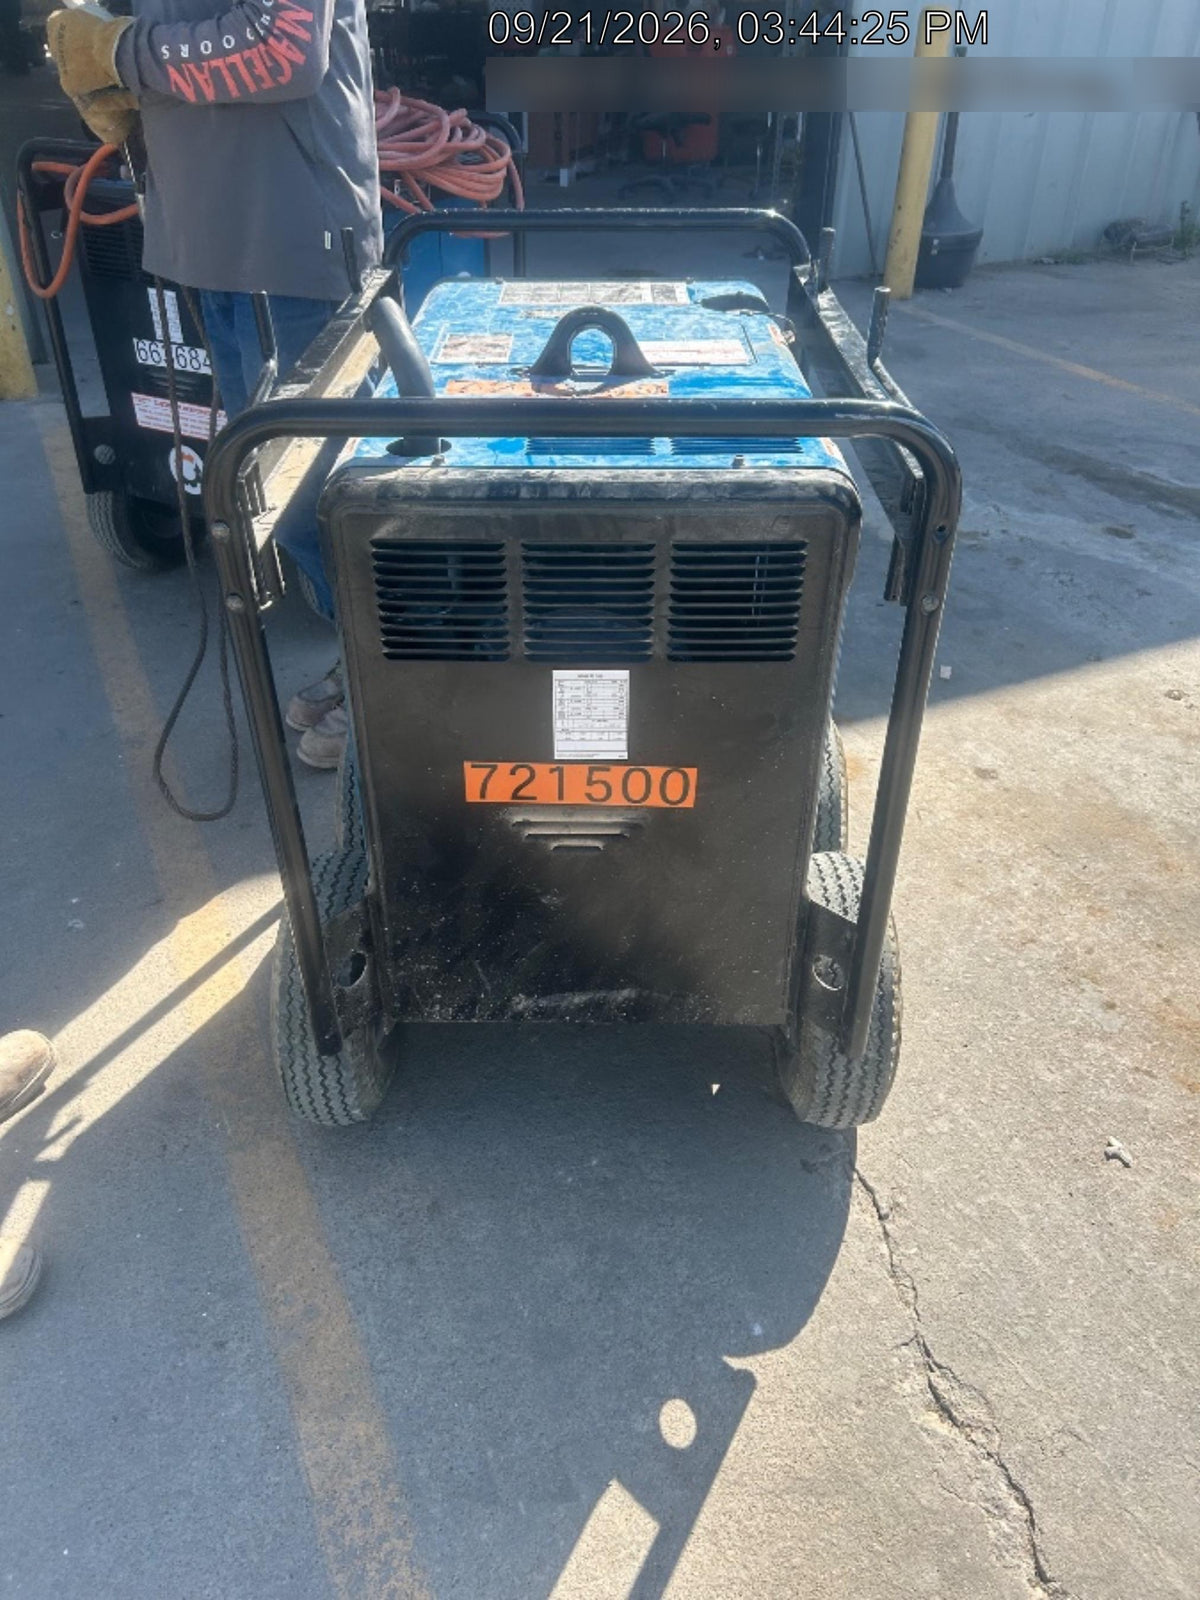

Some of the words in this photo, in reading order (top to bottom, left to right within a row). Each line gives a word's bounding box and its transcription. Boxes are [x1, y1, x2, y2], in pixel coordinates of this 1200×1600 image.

[166, 0, 313, 102] MAGELLAN
[136, 340, 212, 370] 66684
[470, 763, 691, 806] 721500
